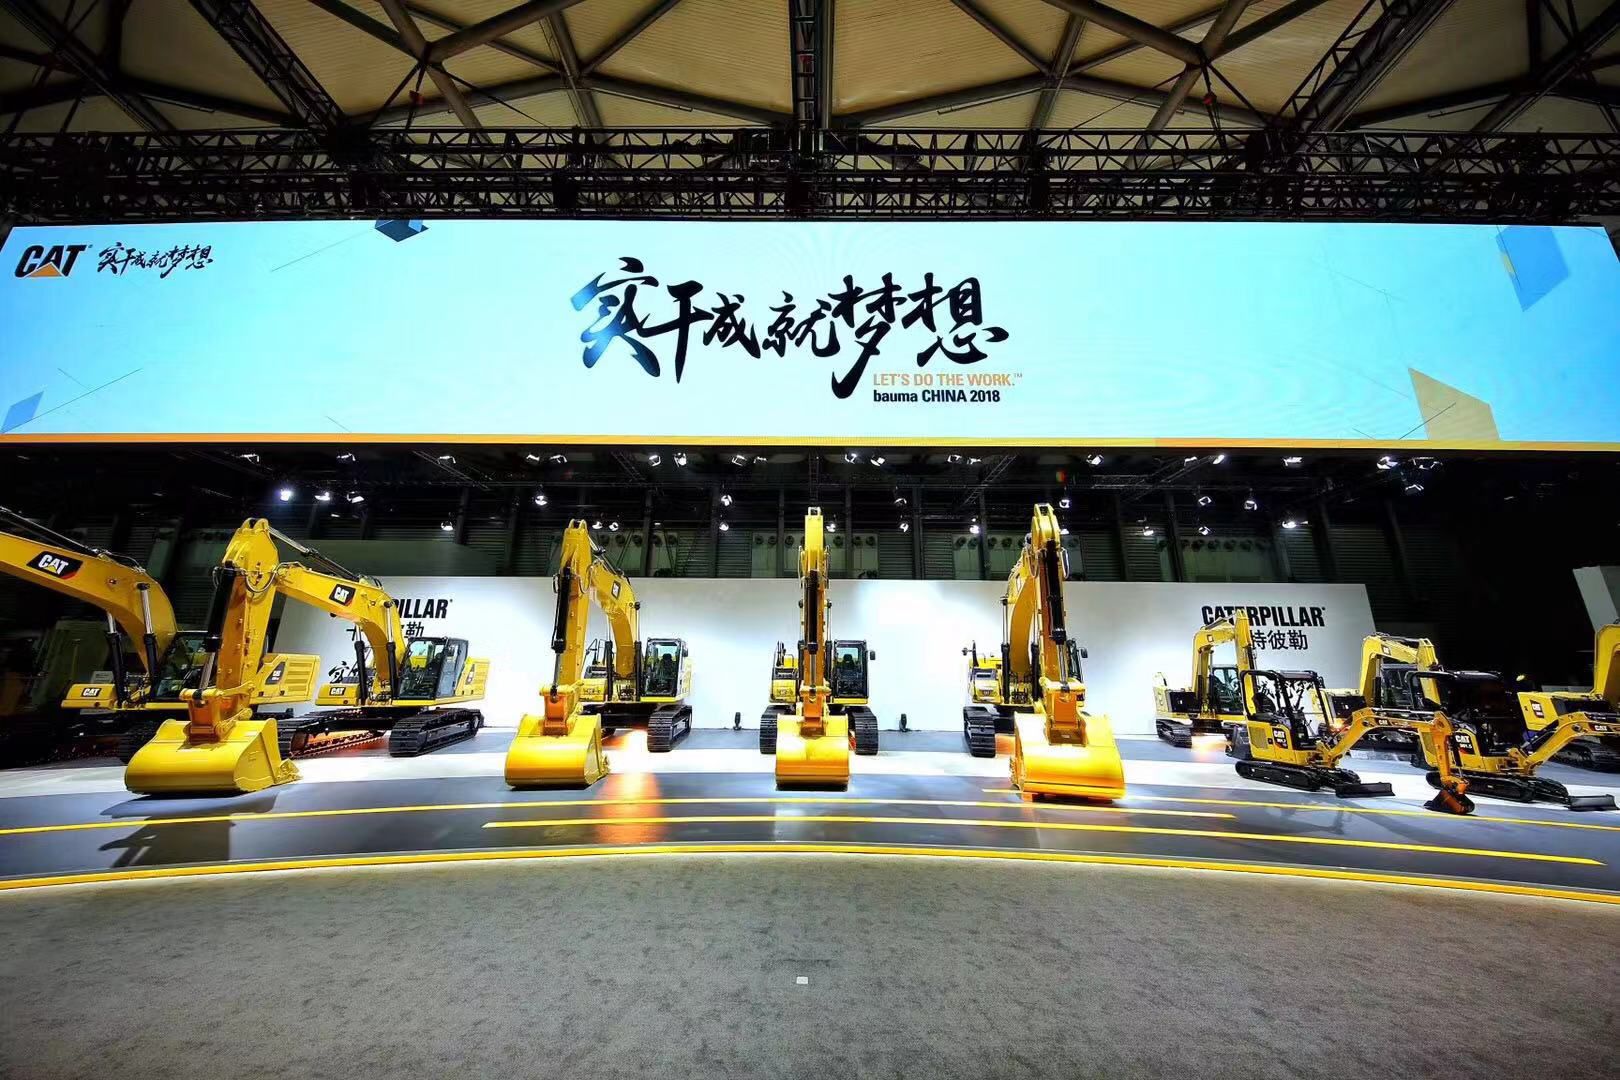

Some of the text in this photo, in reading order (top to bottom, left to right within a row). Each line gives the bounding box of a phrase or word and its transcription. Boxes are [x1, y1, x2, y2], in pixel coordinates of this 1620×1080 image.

[14, 244, 87, 278] CAT
[570, 256, 1009, 399] 实干成就梦想
[873, 373, 910, 386] LET'S
[914, 373, 933, 386] DO
[937, 373, 964, 386] THE
[873, 389, 1000, 403] bauma CHINA 2018
[38, 554, 69, 575] CAT
[334, 586, 350, 603] CAT
[1201, 606, 1325, 627] CATRPILLAR
[83, 688, 100, 697] CAT
[330, 687, 345, 695] CAT
